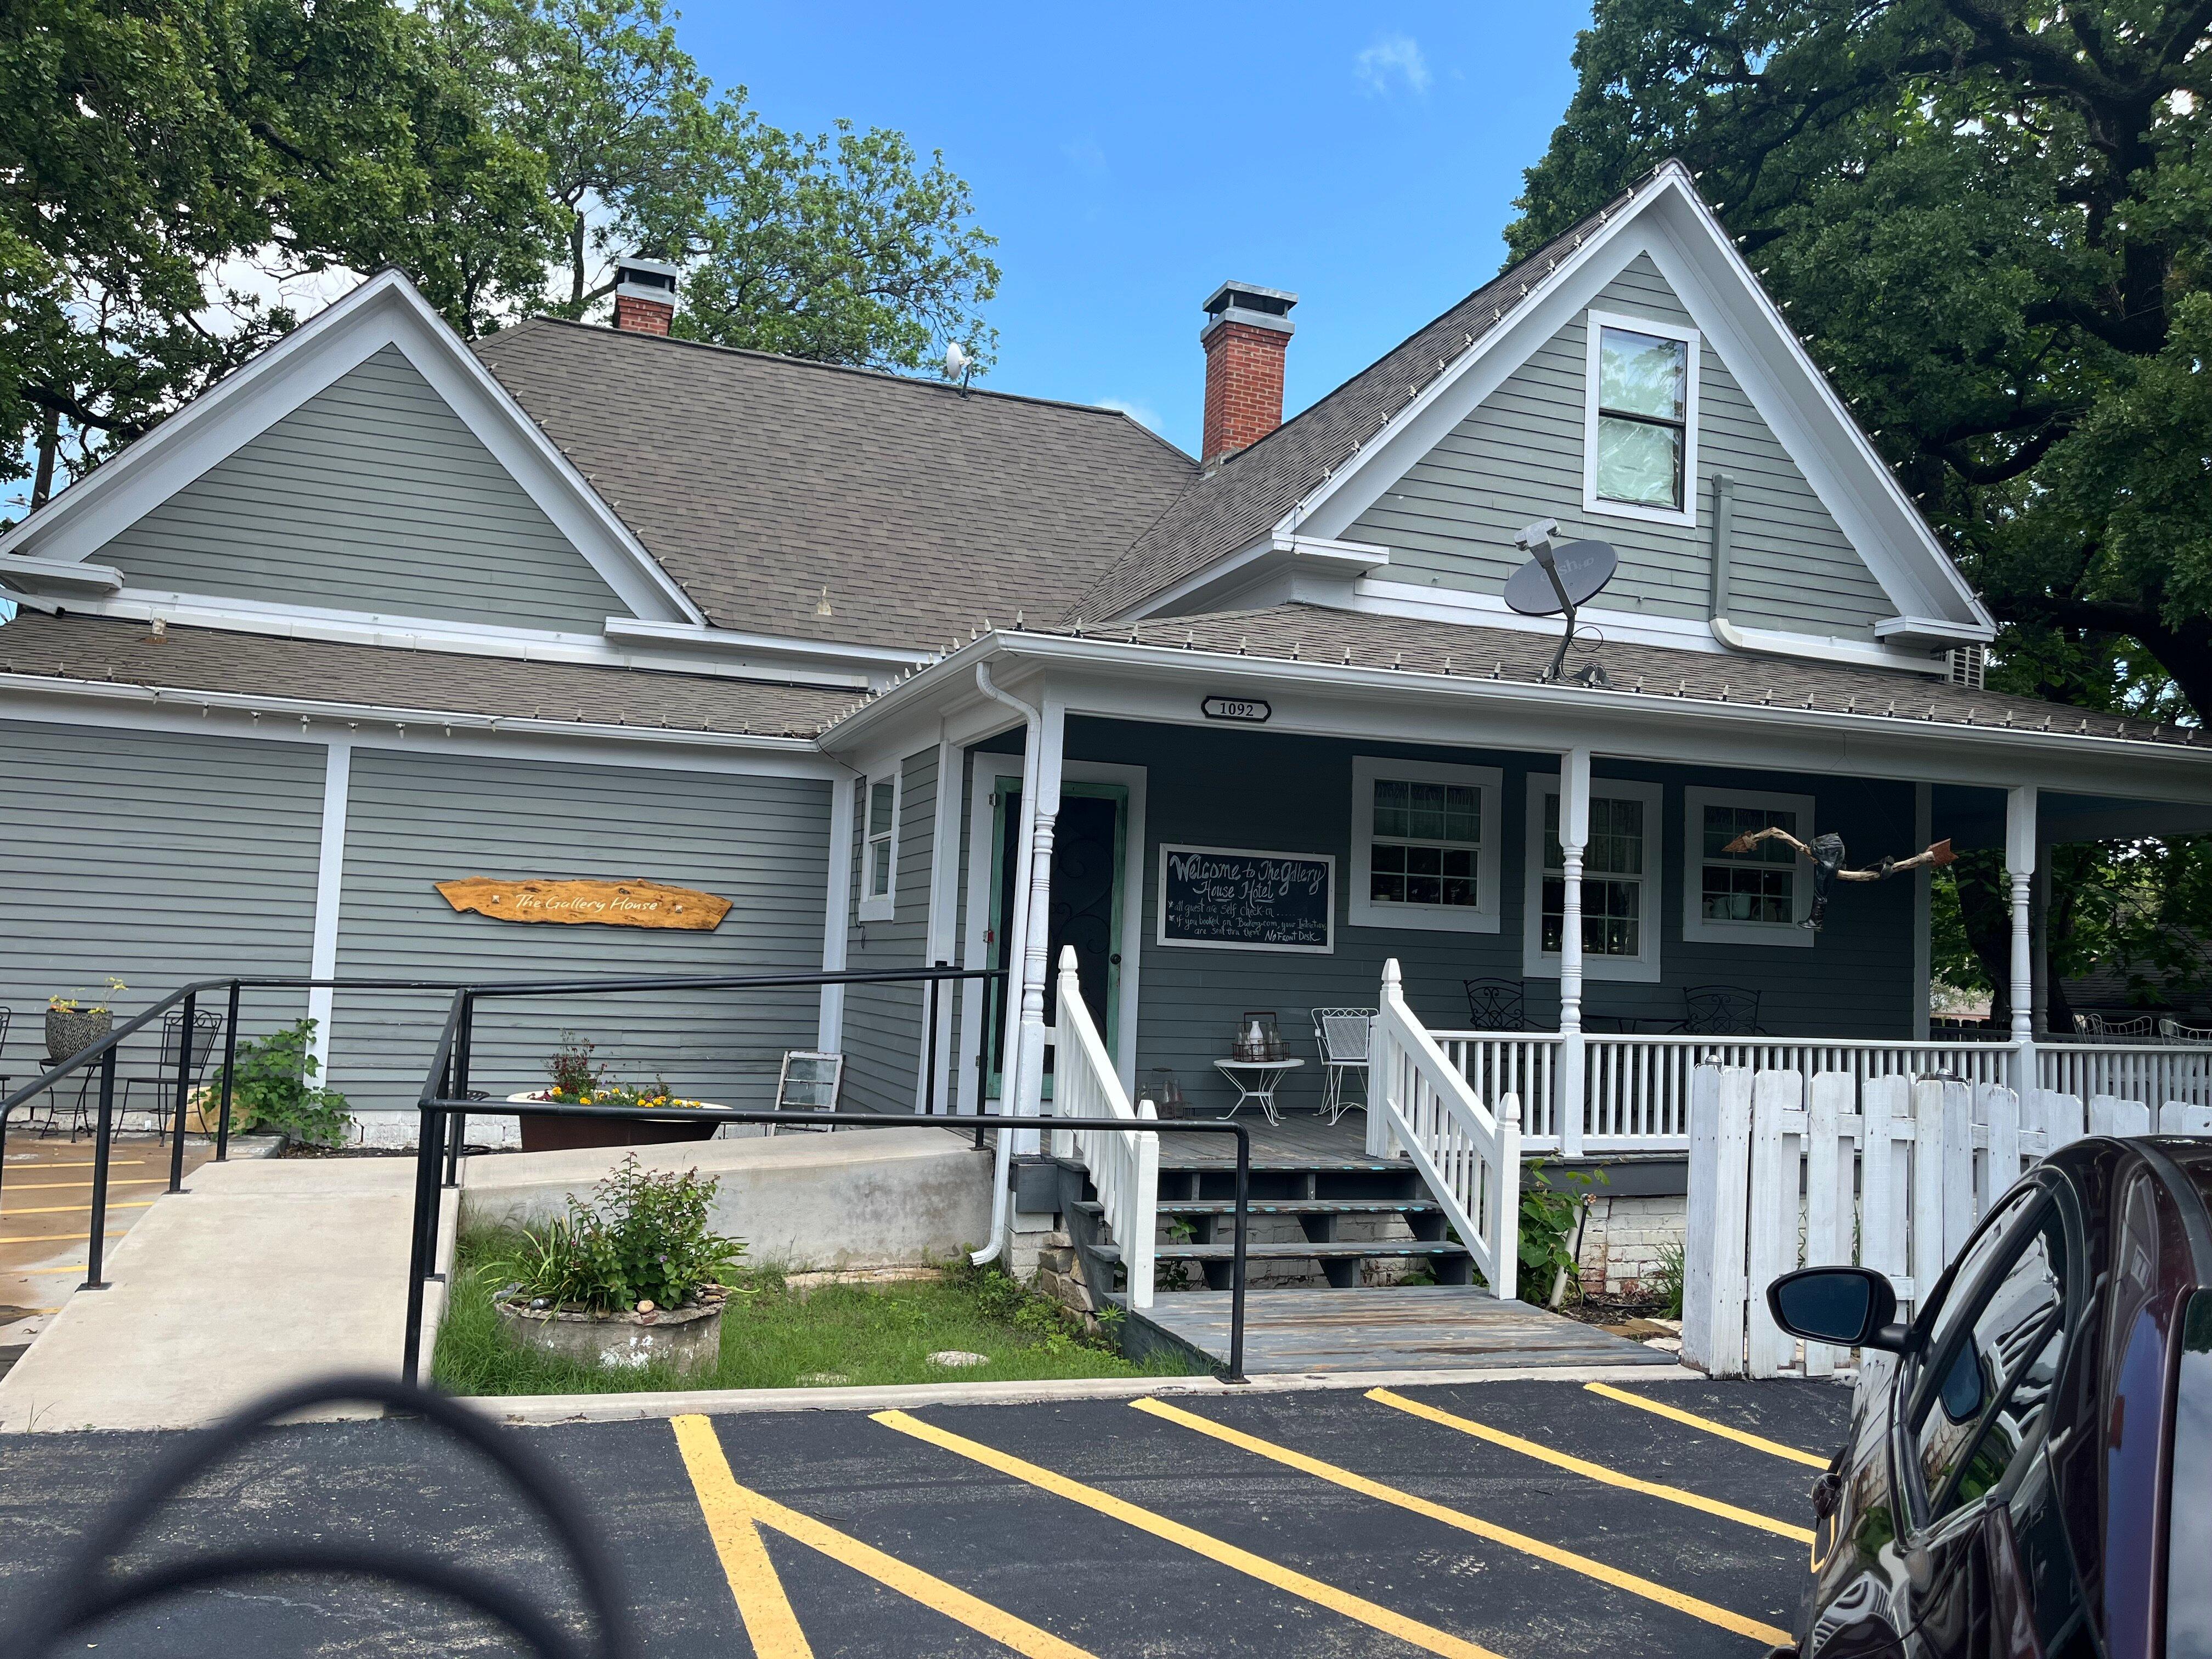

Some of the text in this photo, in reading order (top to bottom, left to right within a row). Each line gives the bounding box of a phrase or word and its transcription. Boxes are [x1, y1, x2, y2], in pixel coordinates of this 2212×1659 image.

[1220, 702, 1254, 716] 1092
[1170, 854, 1241, 883] Welcome
[1242, 861, 1256, 878] to
[1258, 860, 1280, 881] The
[516, 894, 658, 913] The Gallery House
[1193, 879, 1274, 909] House Hotel
[1184, 897, 1205, 918] guest
[1206, 905, 1217, 913] are
[1184, 918, 1198, 930] you
[1199, 914, 1220, 927] booked
[1222, 919, 1233, 928] on
